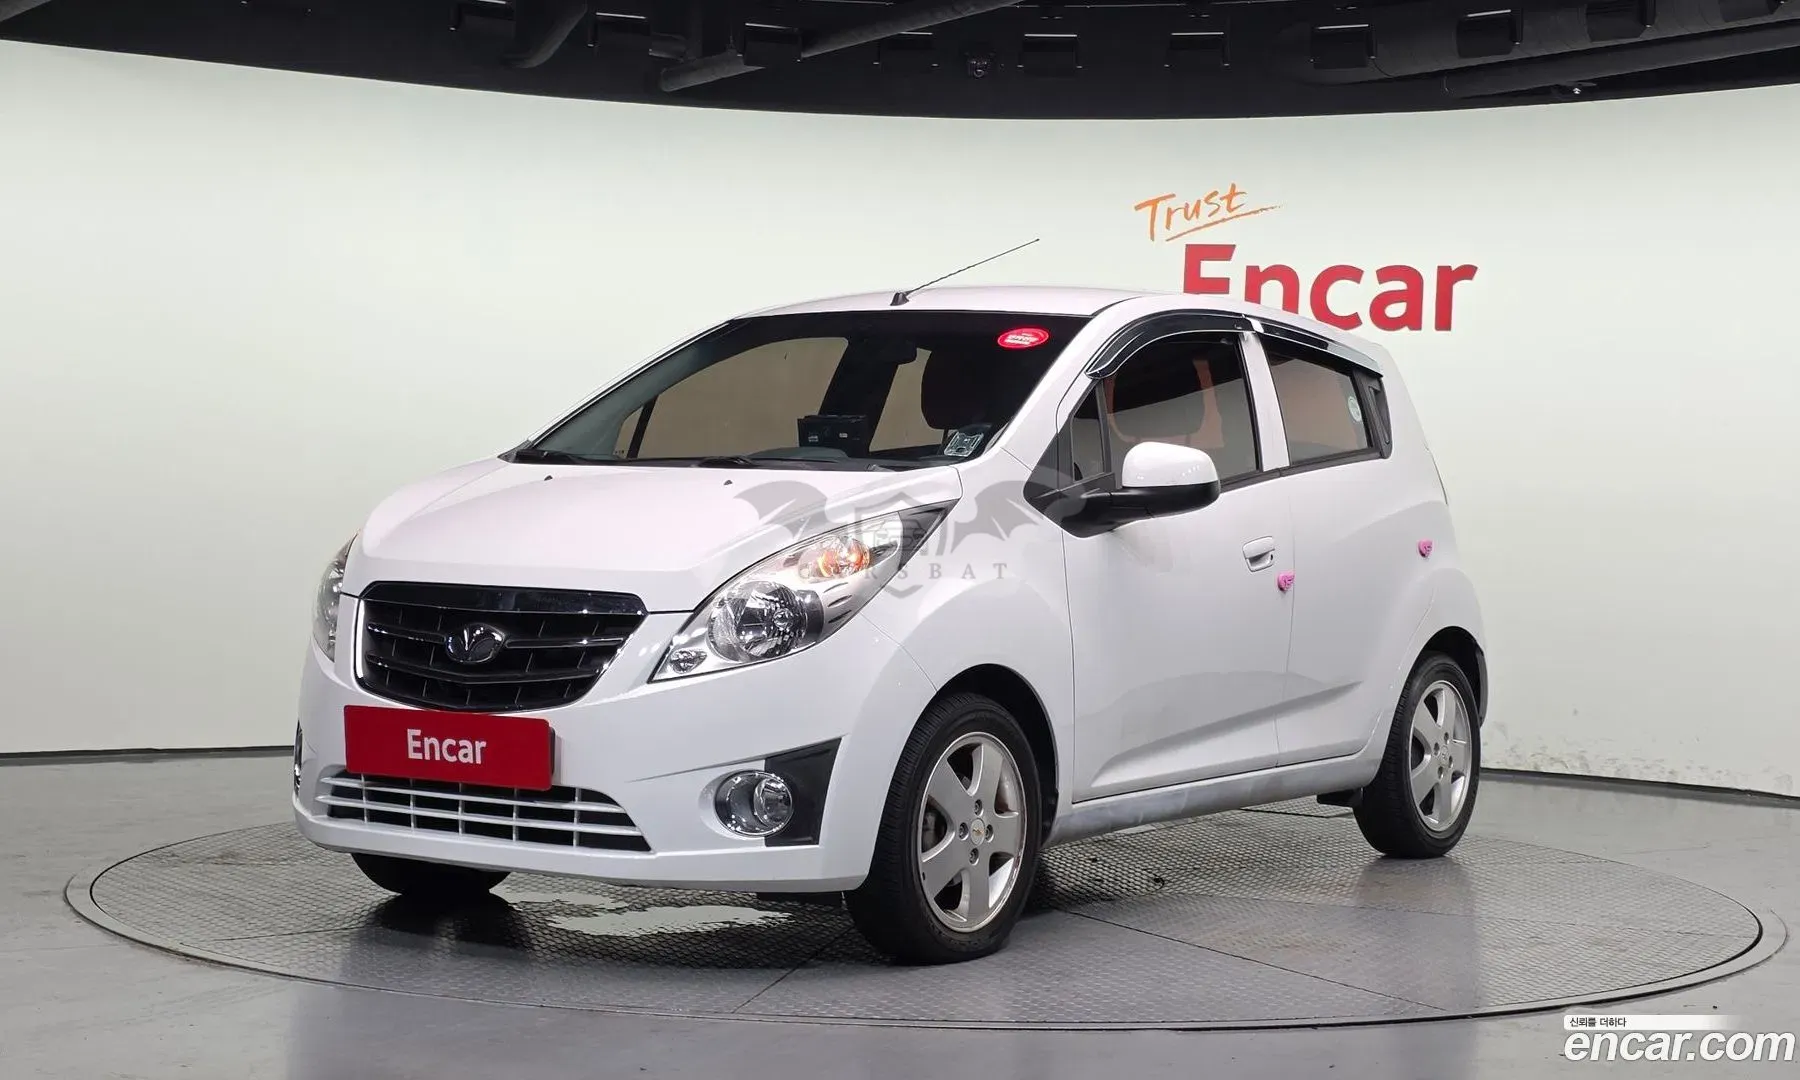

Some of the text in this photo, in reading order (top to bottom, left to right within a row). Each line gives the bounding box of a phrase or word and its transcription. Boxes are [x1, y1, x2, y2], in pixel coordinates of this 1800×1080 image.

[1134, 182, 1247, 241] Trust
[1183, 244, 1478, 331] Encar
[407, 728, 486, 764] Encar
